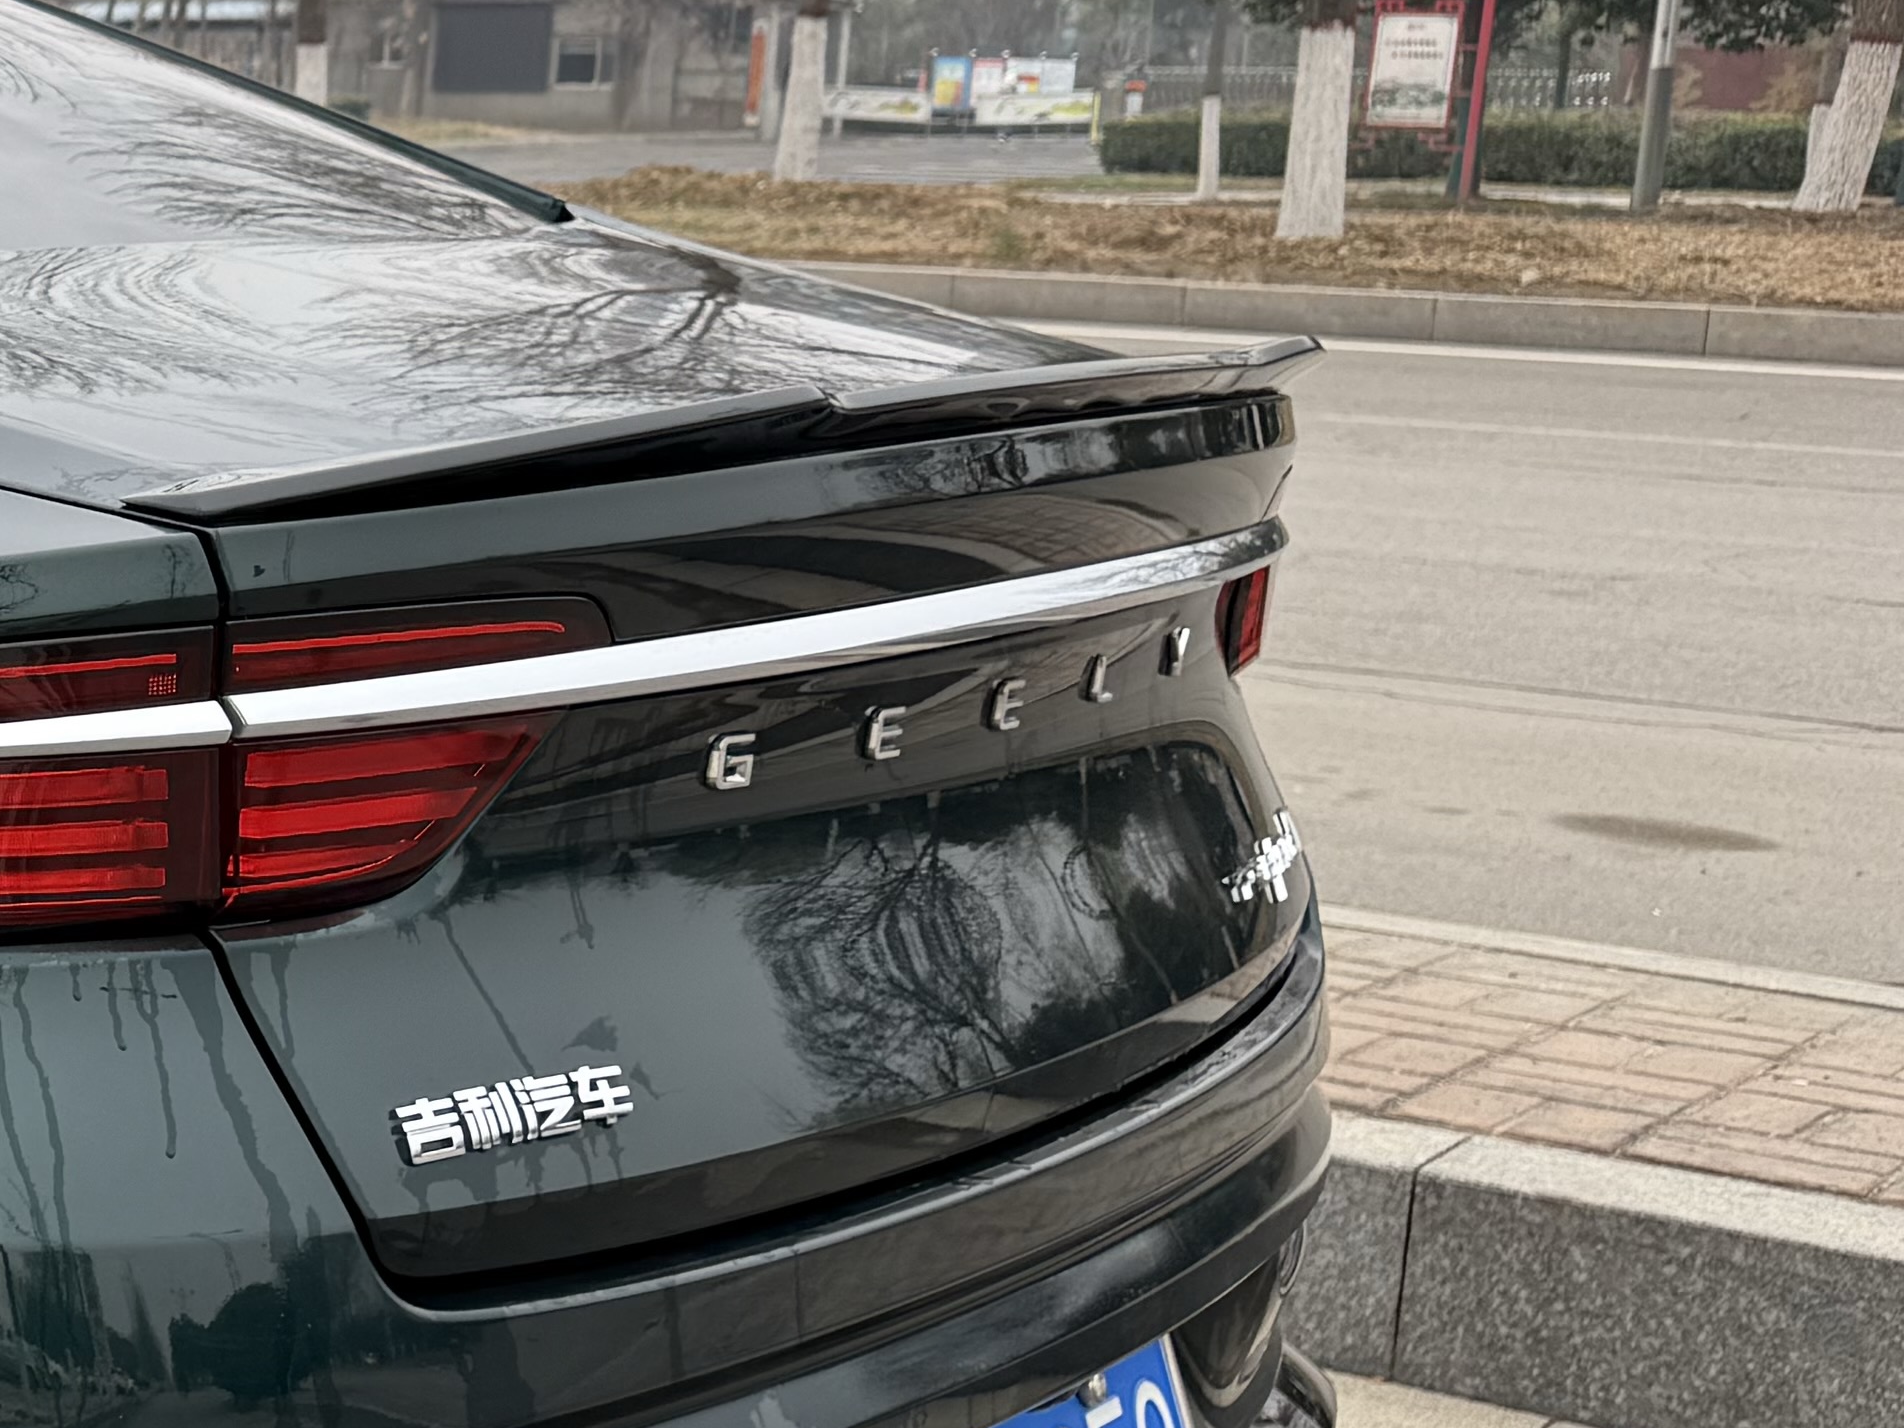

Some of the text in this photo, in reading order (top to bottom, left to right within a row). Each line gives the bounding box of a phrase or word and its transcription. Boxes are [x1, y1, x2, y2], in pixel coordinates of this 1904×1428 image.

[705, 625, 1190, 790] GEELY
[392, 1064, 634, 1166] 吉利汽车
